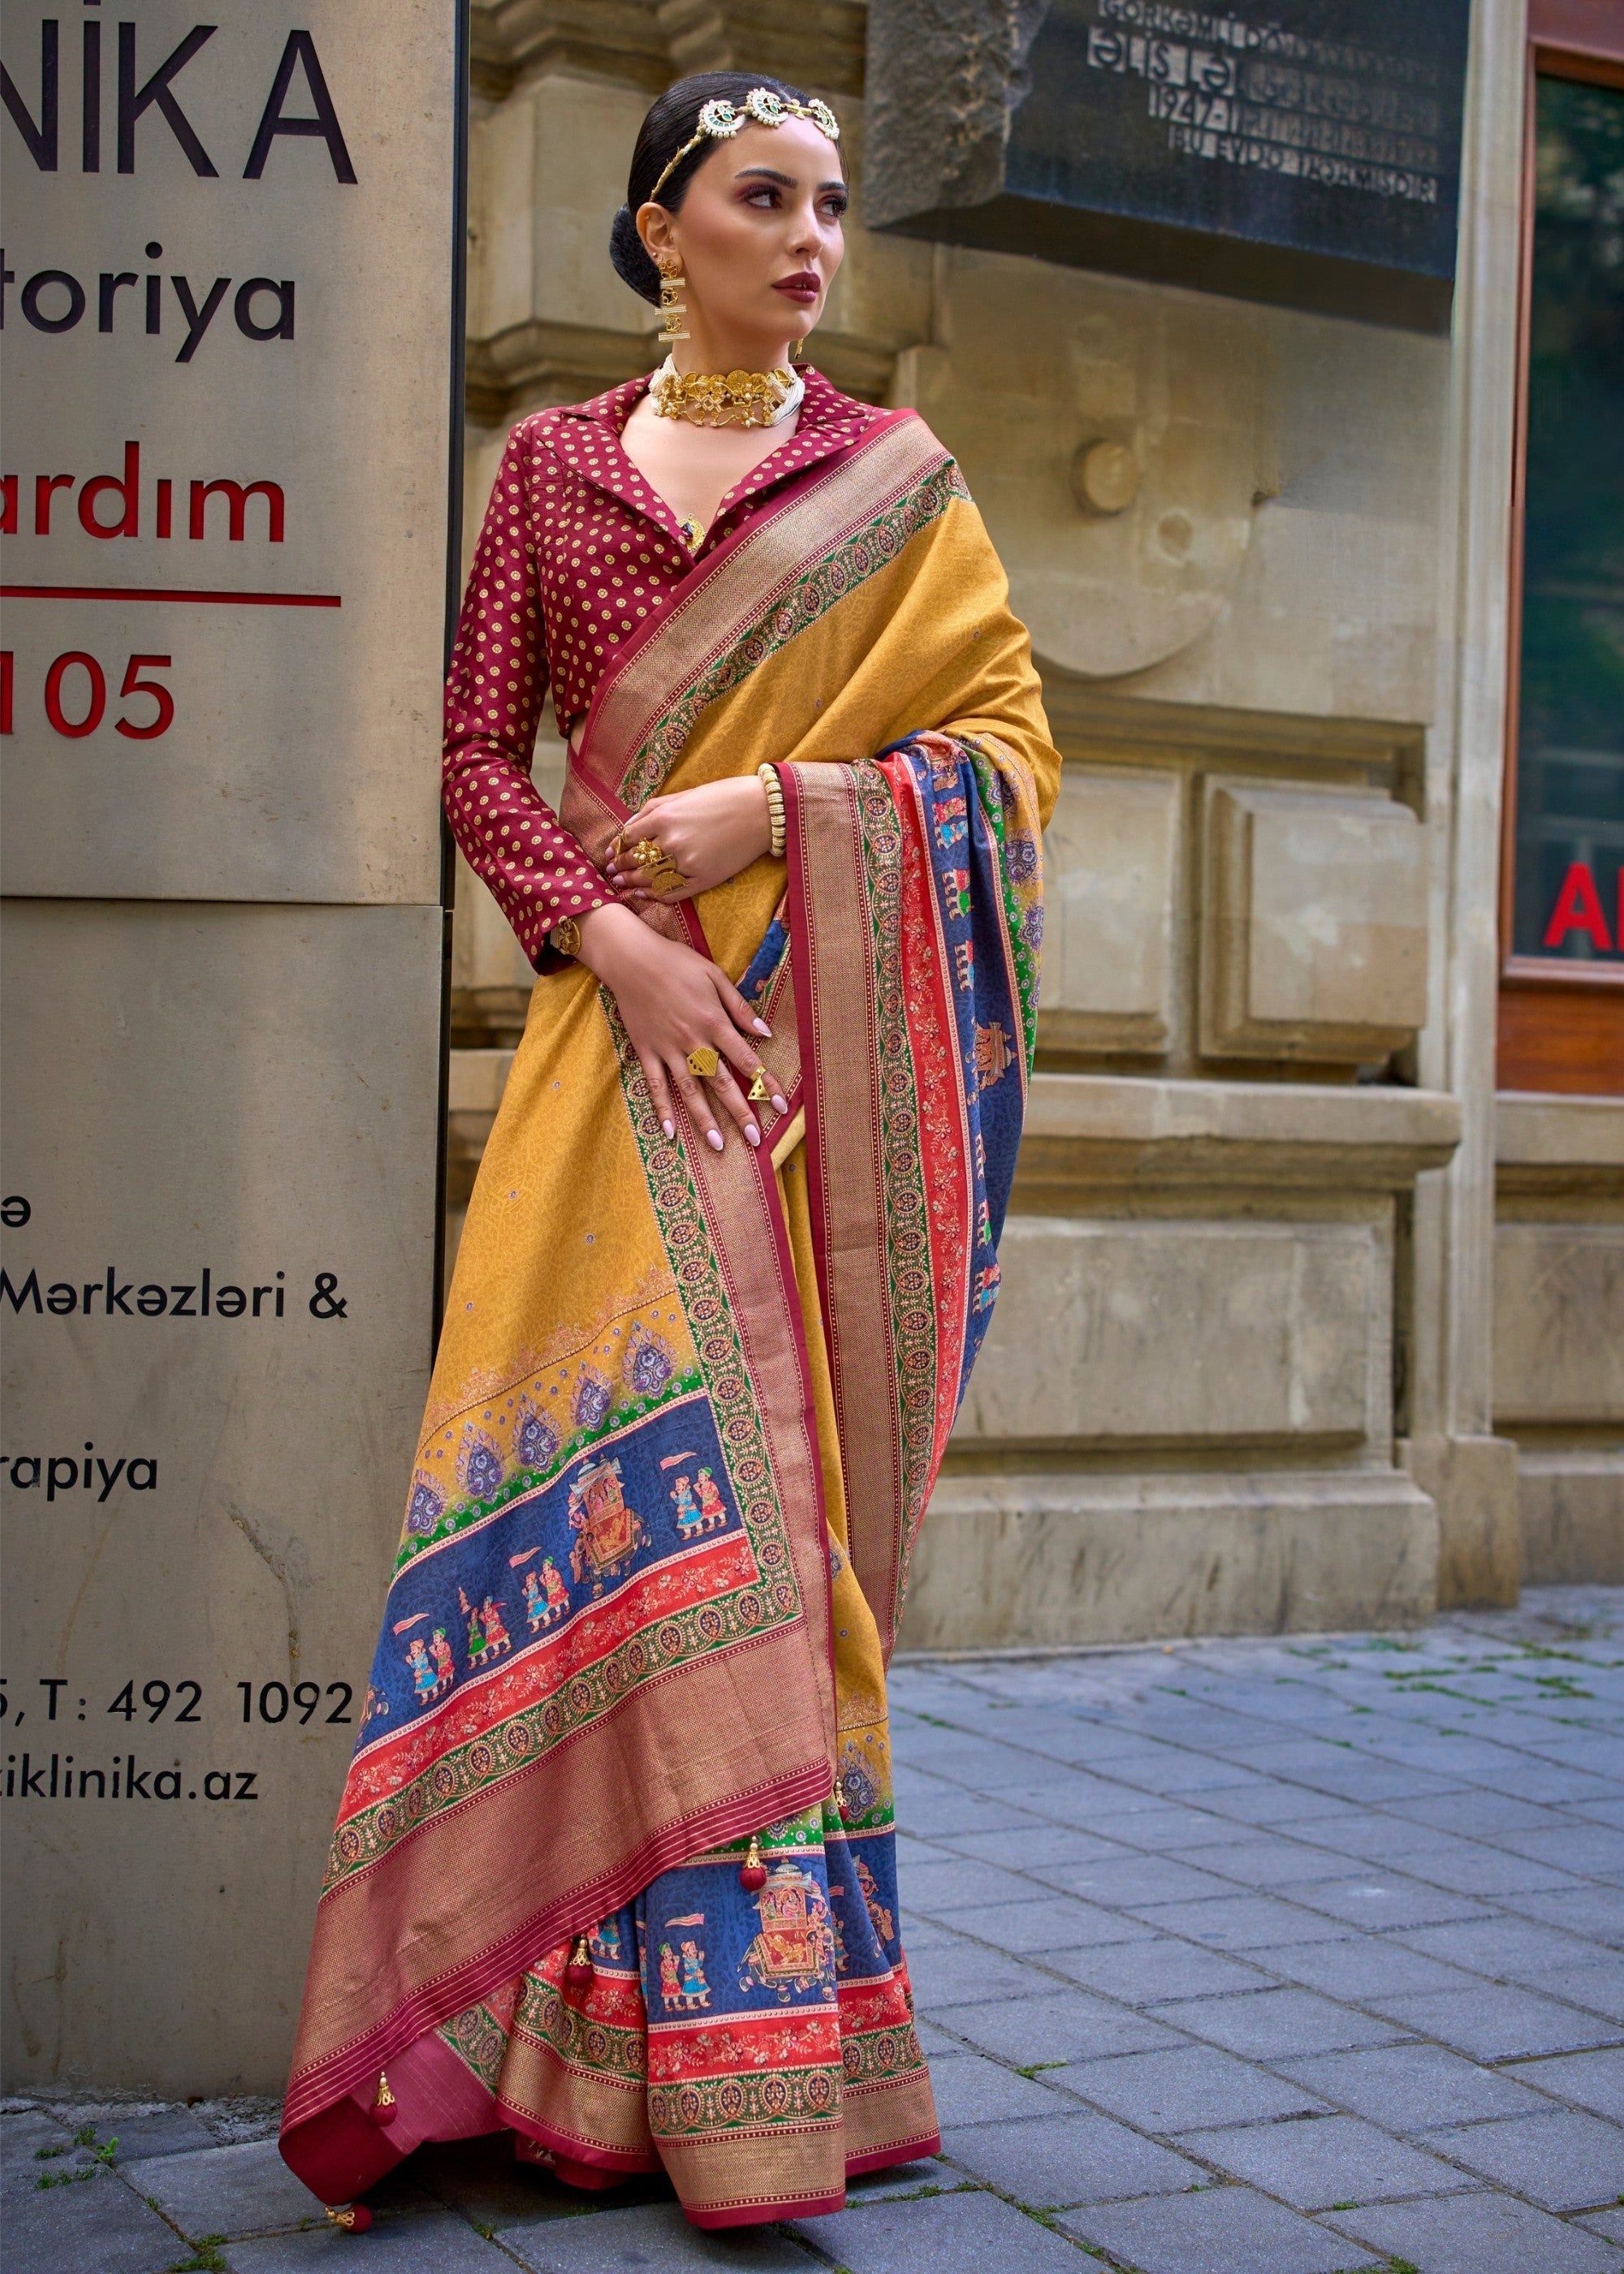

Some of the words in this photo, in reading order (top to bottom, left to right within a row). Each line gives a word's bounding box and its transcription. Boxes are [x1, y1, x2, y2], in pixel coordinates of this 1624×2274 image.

[0, 651, 174, 740] 105
[1544, 862, 1624, 952] A
[0, 1267, 284, 1317] Mərkəzləri
[309, 1273, 348, 1318] &
[0, 1442, 157, 1502] apiya
[107, 1680, 202, 1723] 492
[237, 1682, 352, 1725] 1092
[0, 1753, 258, 1800] iklinika.az
